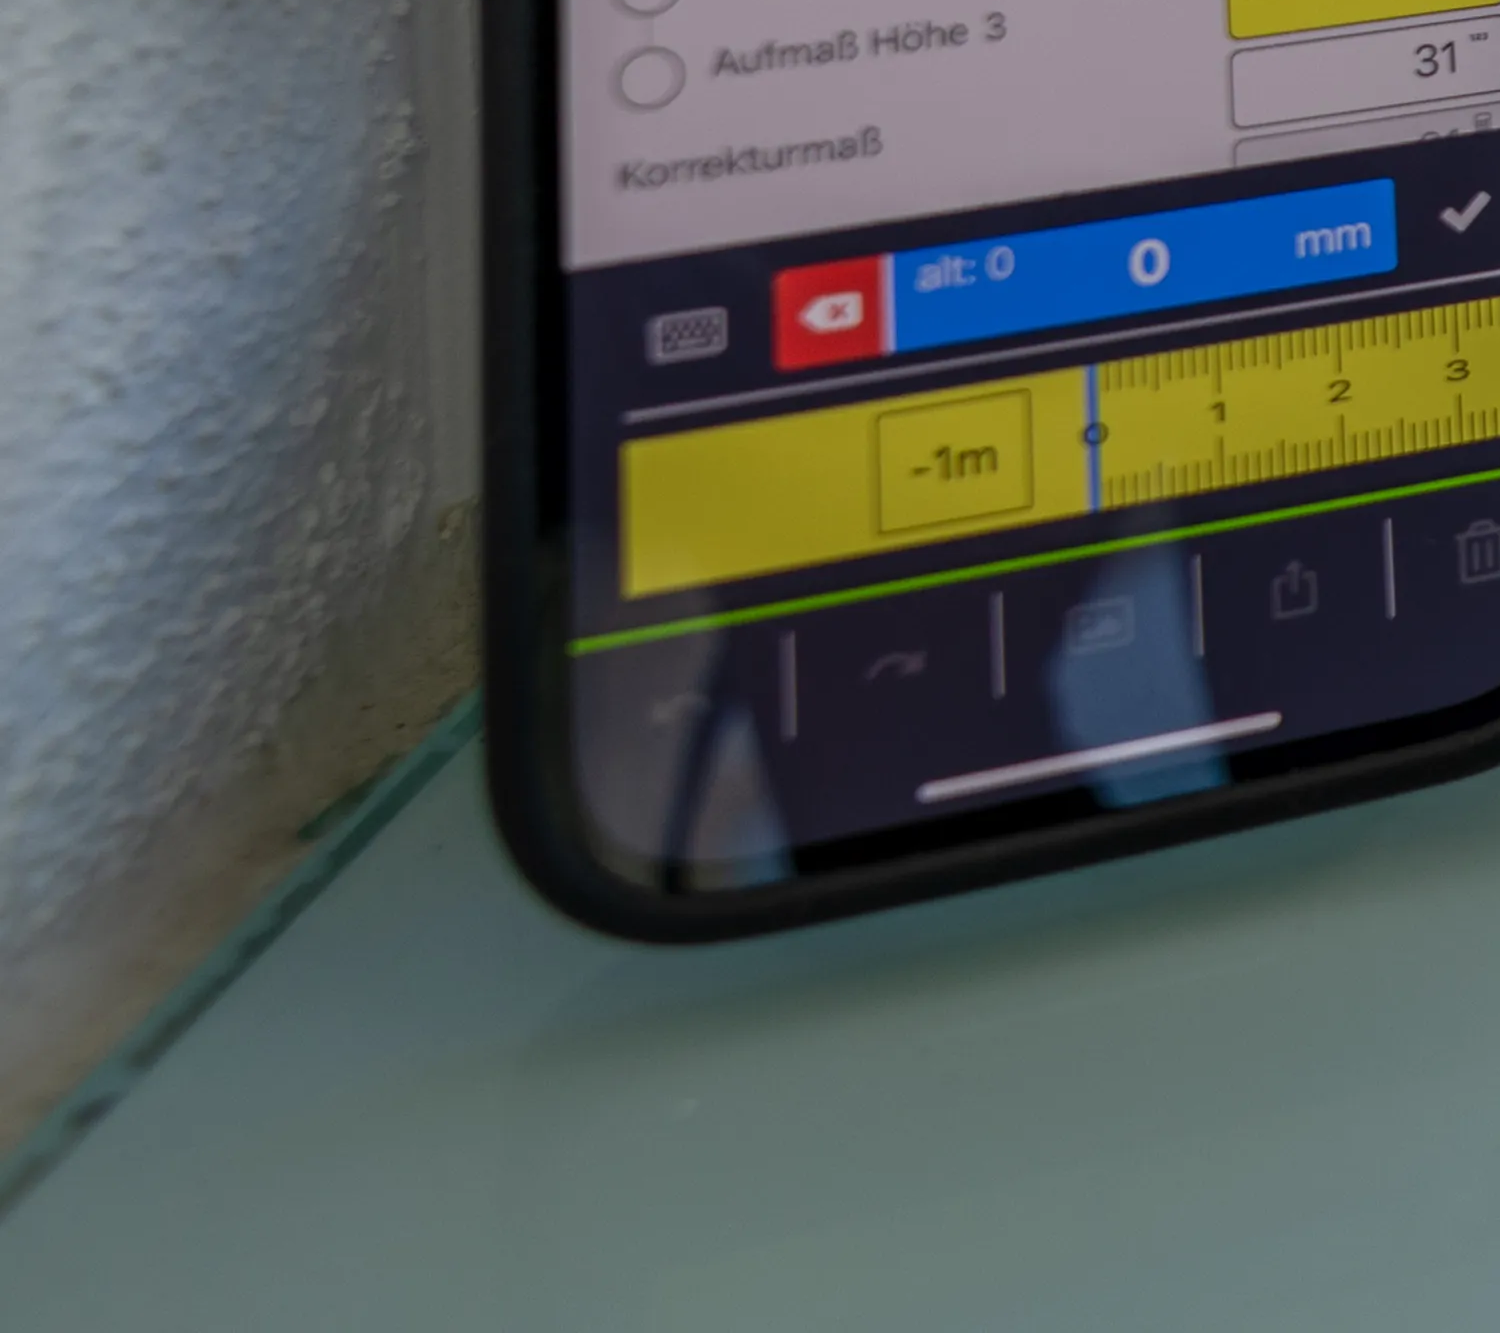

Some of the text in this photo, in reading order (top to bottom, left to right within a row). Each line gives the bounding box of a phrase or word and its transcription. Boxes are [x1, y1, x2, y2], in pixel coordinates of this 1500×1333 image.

[711, 12, 1007, 77] Aufmaß Höhe 3
[1415, 41, 1456, 77] 31
[616, 125, 883, 191] Korrekturmaß
[914, 245, 1015, 293] alt: 0
[1128, 219, 1372, 286] 0 mm
[1211, 401, 1227, 423] 1
[1327, 379, 1352, 403] 2
[1446, 359, 1470, 382] 3
